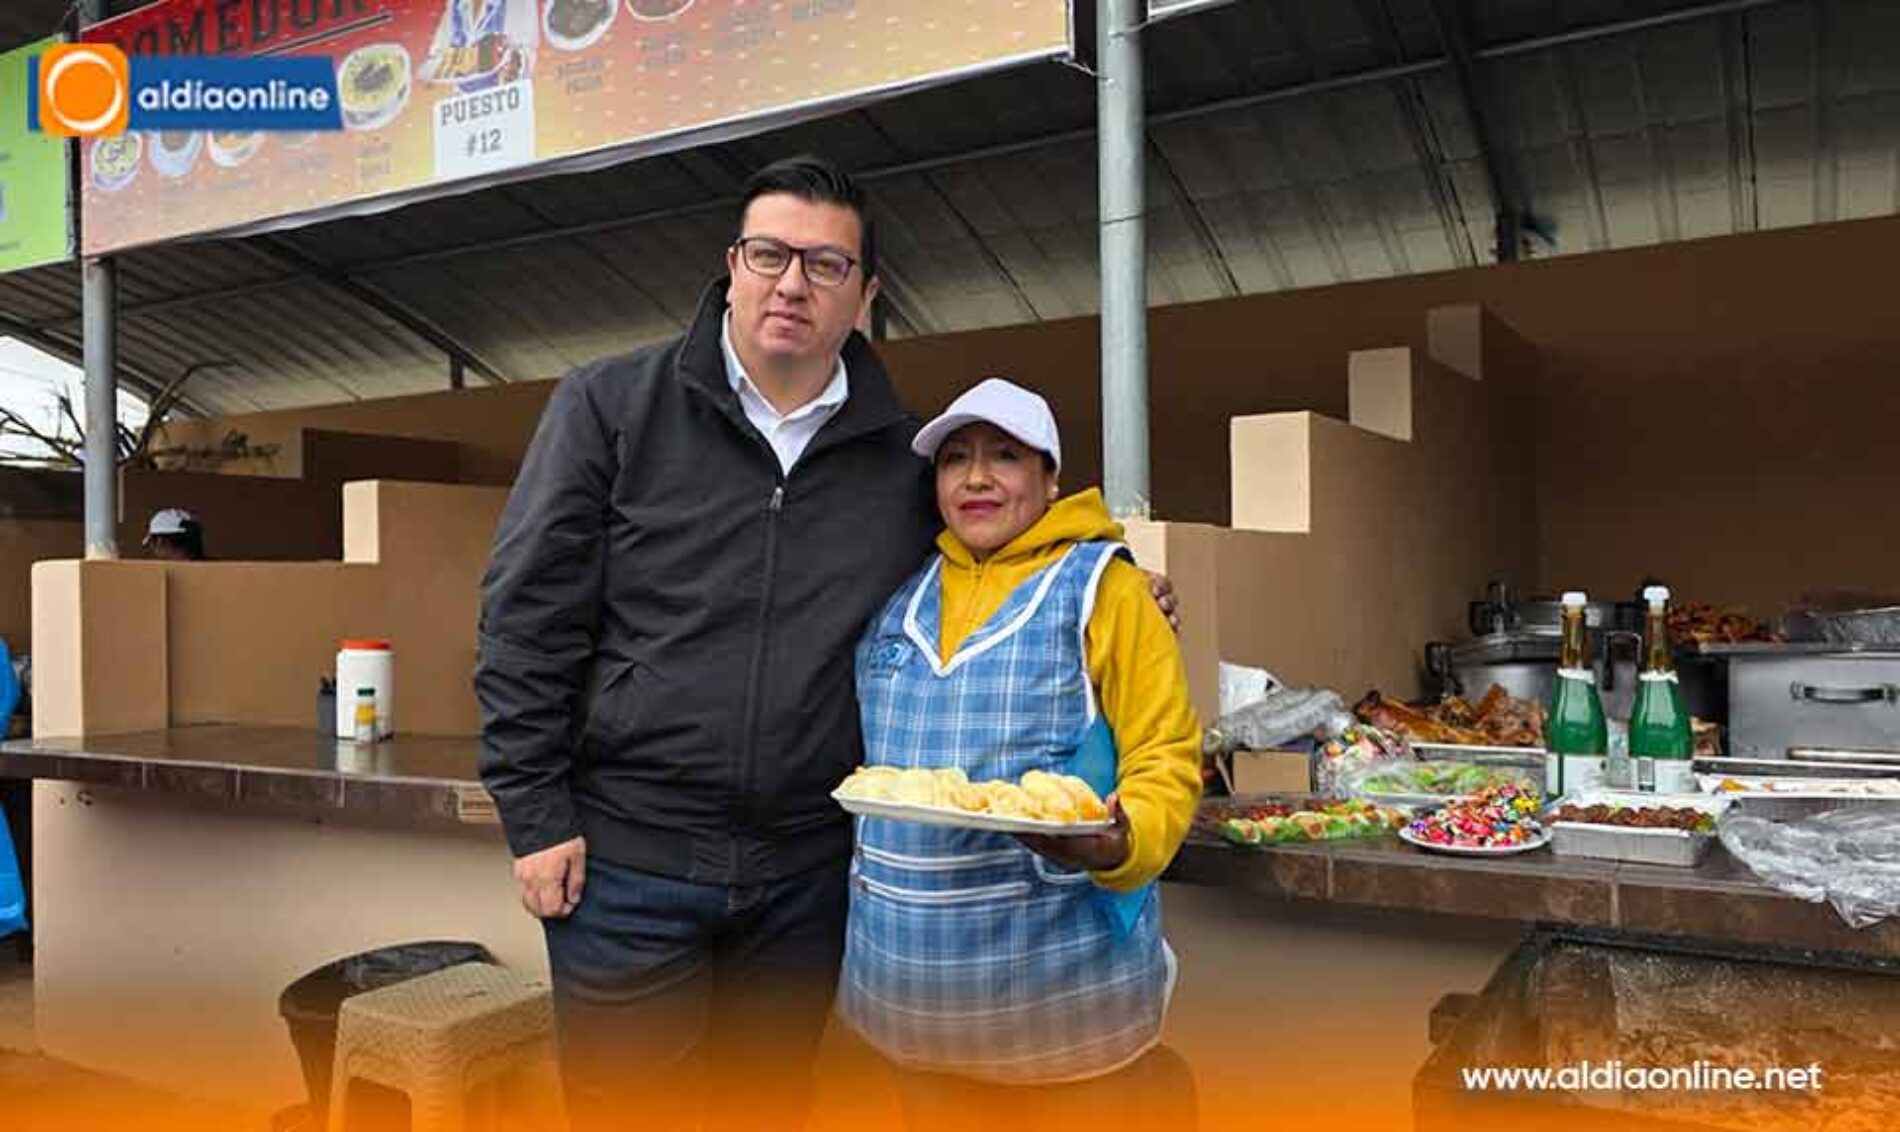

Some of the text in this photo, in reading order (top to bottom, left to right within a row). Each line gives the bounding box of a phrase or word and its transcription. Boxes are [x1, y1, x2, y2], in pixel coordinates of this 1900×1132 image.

[113, 0, 366, 57] OMEDO
[441, 86, 519, 126] PUESTO
[467, 128, 502, 158] #12
